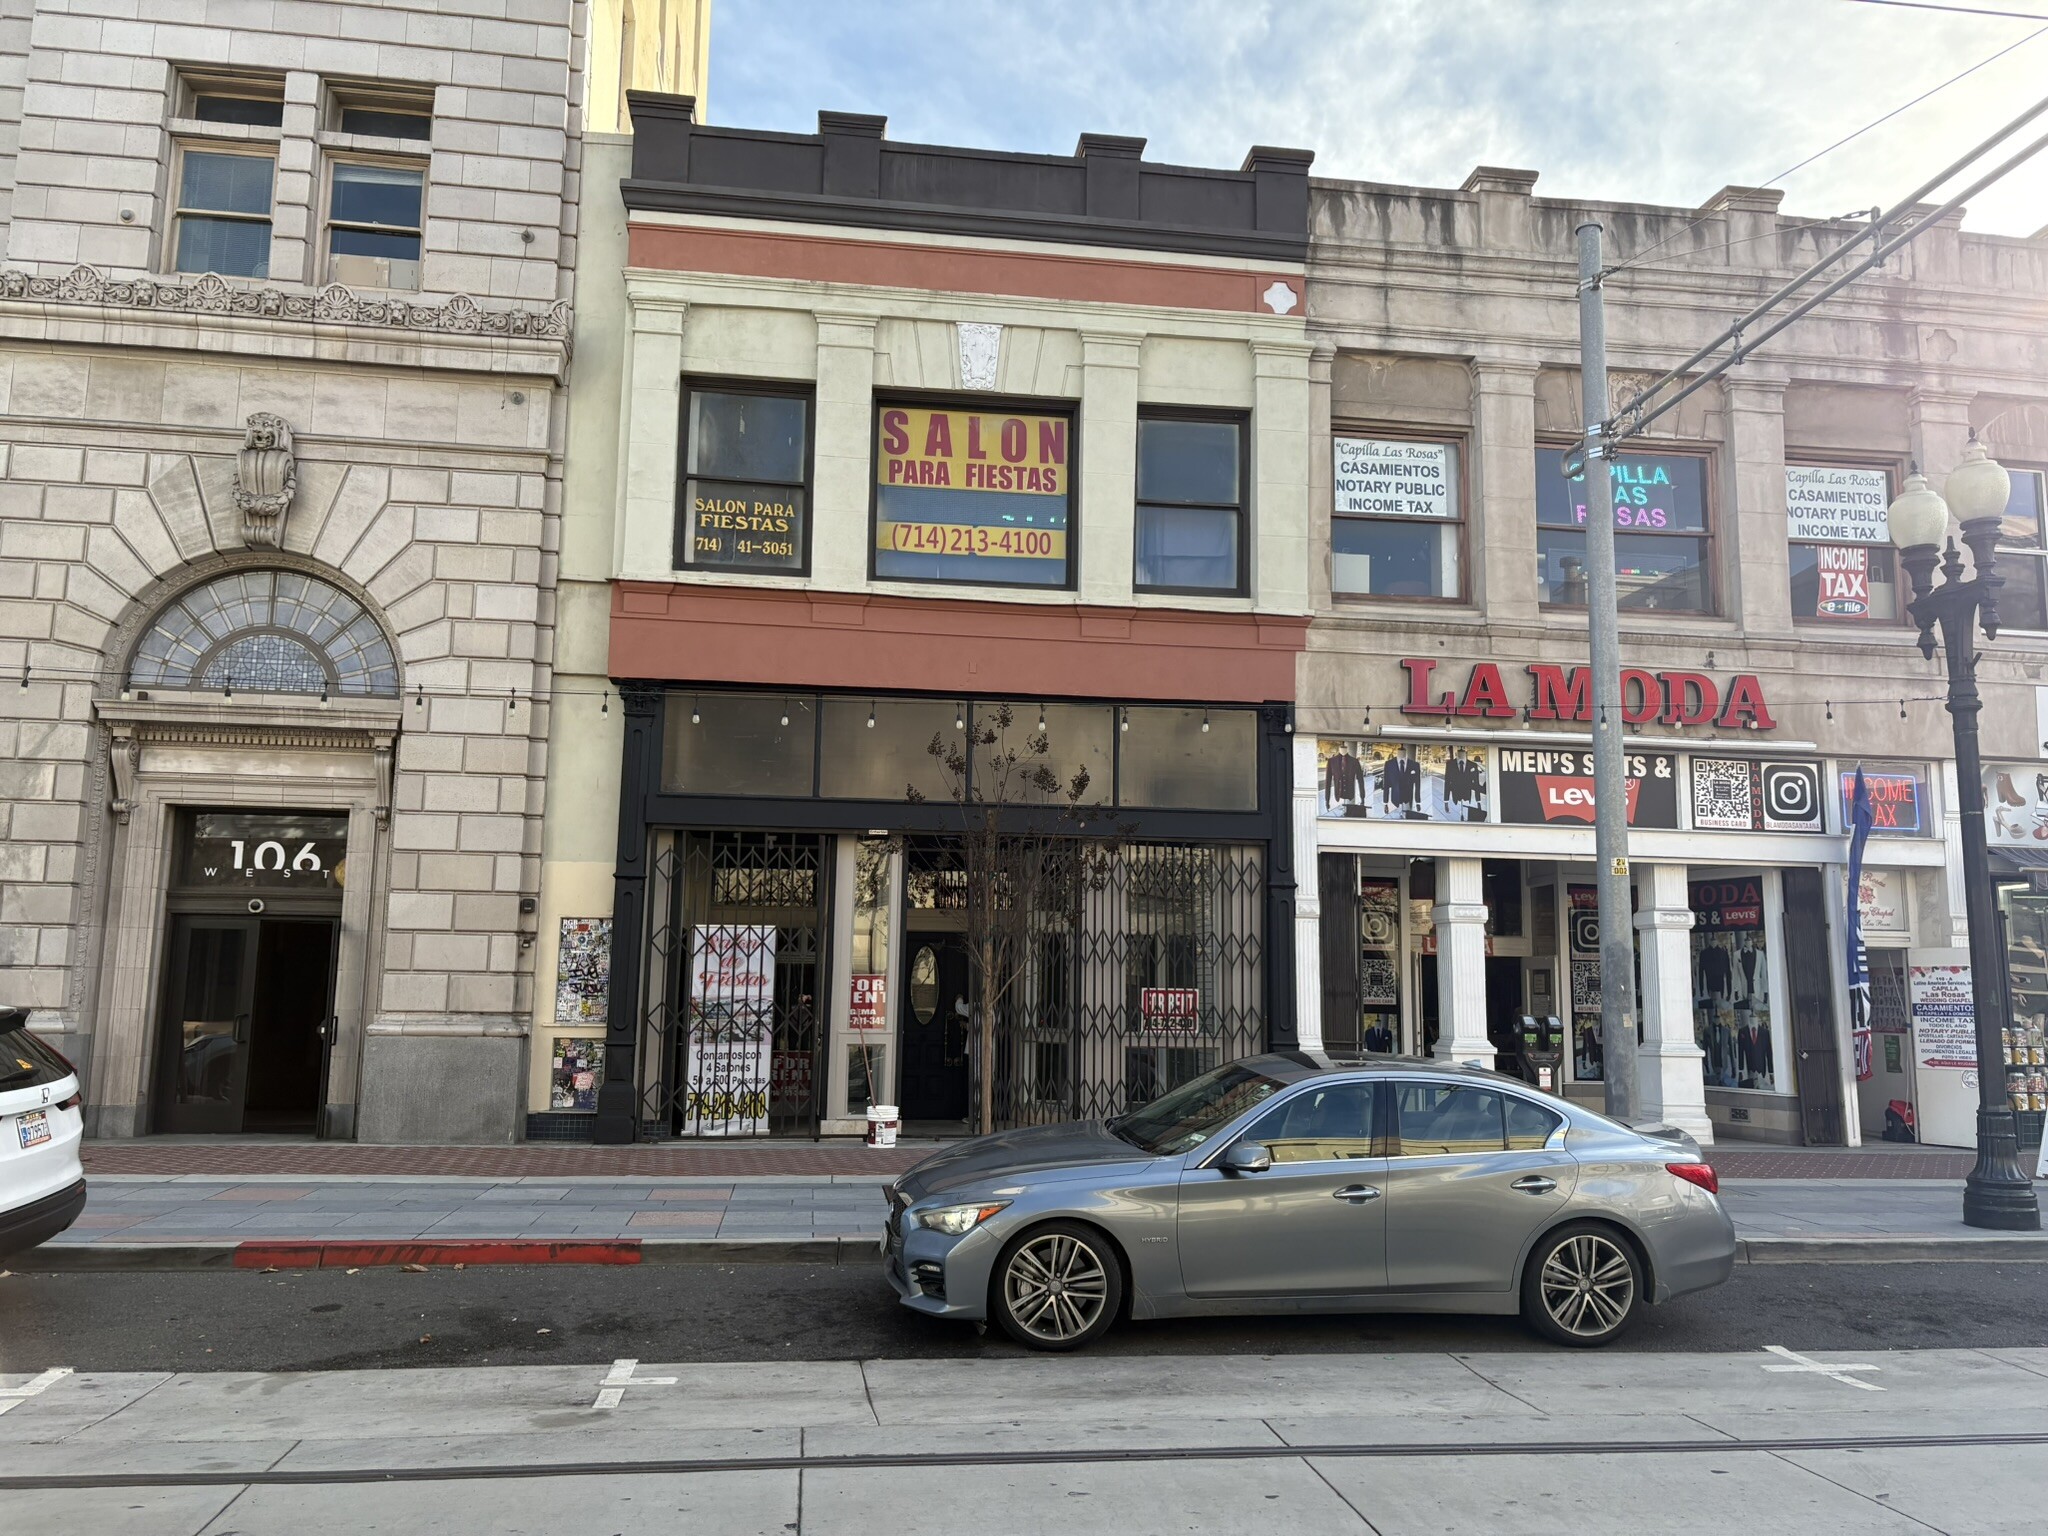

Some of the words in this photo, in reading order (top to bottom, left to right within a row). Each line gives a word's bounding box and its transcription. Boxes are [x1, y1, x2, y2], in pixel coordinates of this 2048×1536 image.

[883, 410, 1065, 464] SALON
[1382, 446, 1402, 457] Las
[888, 459, 951, 486] PARA
[965, 463, 1057, 493] FIESTAS
[1340, 461, 1440, 478] CASAMIENTOS
[1336, 479, 1391, 494] NOTARY
[1395, 483, 1445, 496] PUBLIC
[1827, 473, 1847, 485] Las
[1614, 485, 1648, 505] AS
[1788, 489, 1882, 505] CASAMIENTOS
[695, 497, 747, 514] SALON
[754, 502, 796, 517] PARA
[1349, 498, 1403, 512] INCOME
[1407, 501, 1433, 513] TAX
[1786, 507, 1837, 520] NOTARY
[1840, 509, 1887, 522] PUBLIC
[700, 514, 790, 533] FIESTAS
[1798, 524, 1848, 538] INCOME
[1851, 527, 1877, 539] TAX
[737, 540, 793, 556] 41-3051
[1820, 546, 1865, 571] INCOME
[1820, 572, 1867, 597] TAX
[1400, 658, 1517, 717] LA
[1524, 664, 1778, 729] MODA
[1501, 750, 1575, 774] MEN'S
[1582, 753, 1647, 777] STS
[1654, 757, 1672, 778] &
[1700, 819, 1730, 827] BUSINESS
[1869, 803, 1897, 826] AX
[231, 840, 321, 871] 106
[696, 1050, 743, 1060] Conamos
[706, 1063, 712, 1072] 4
